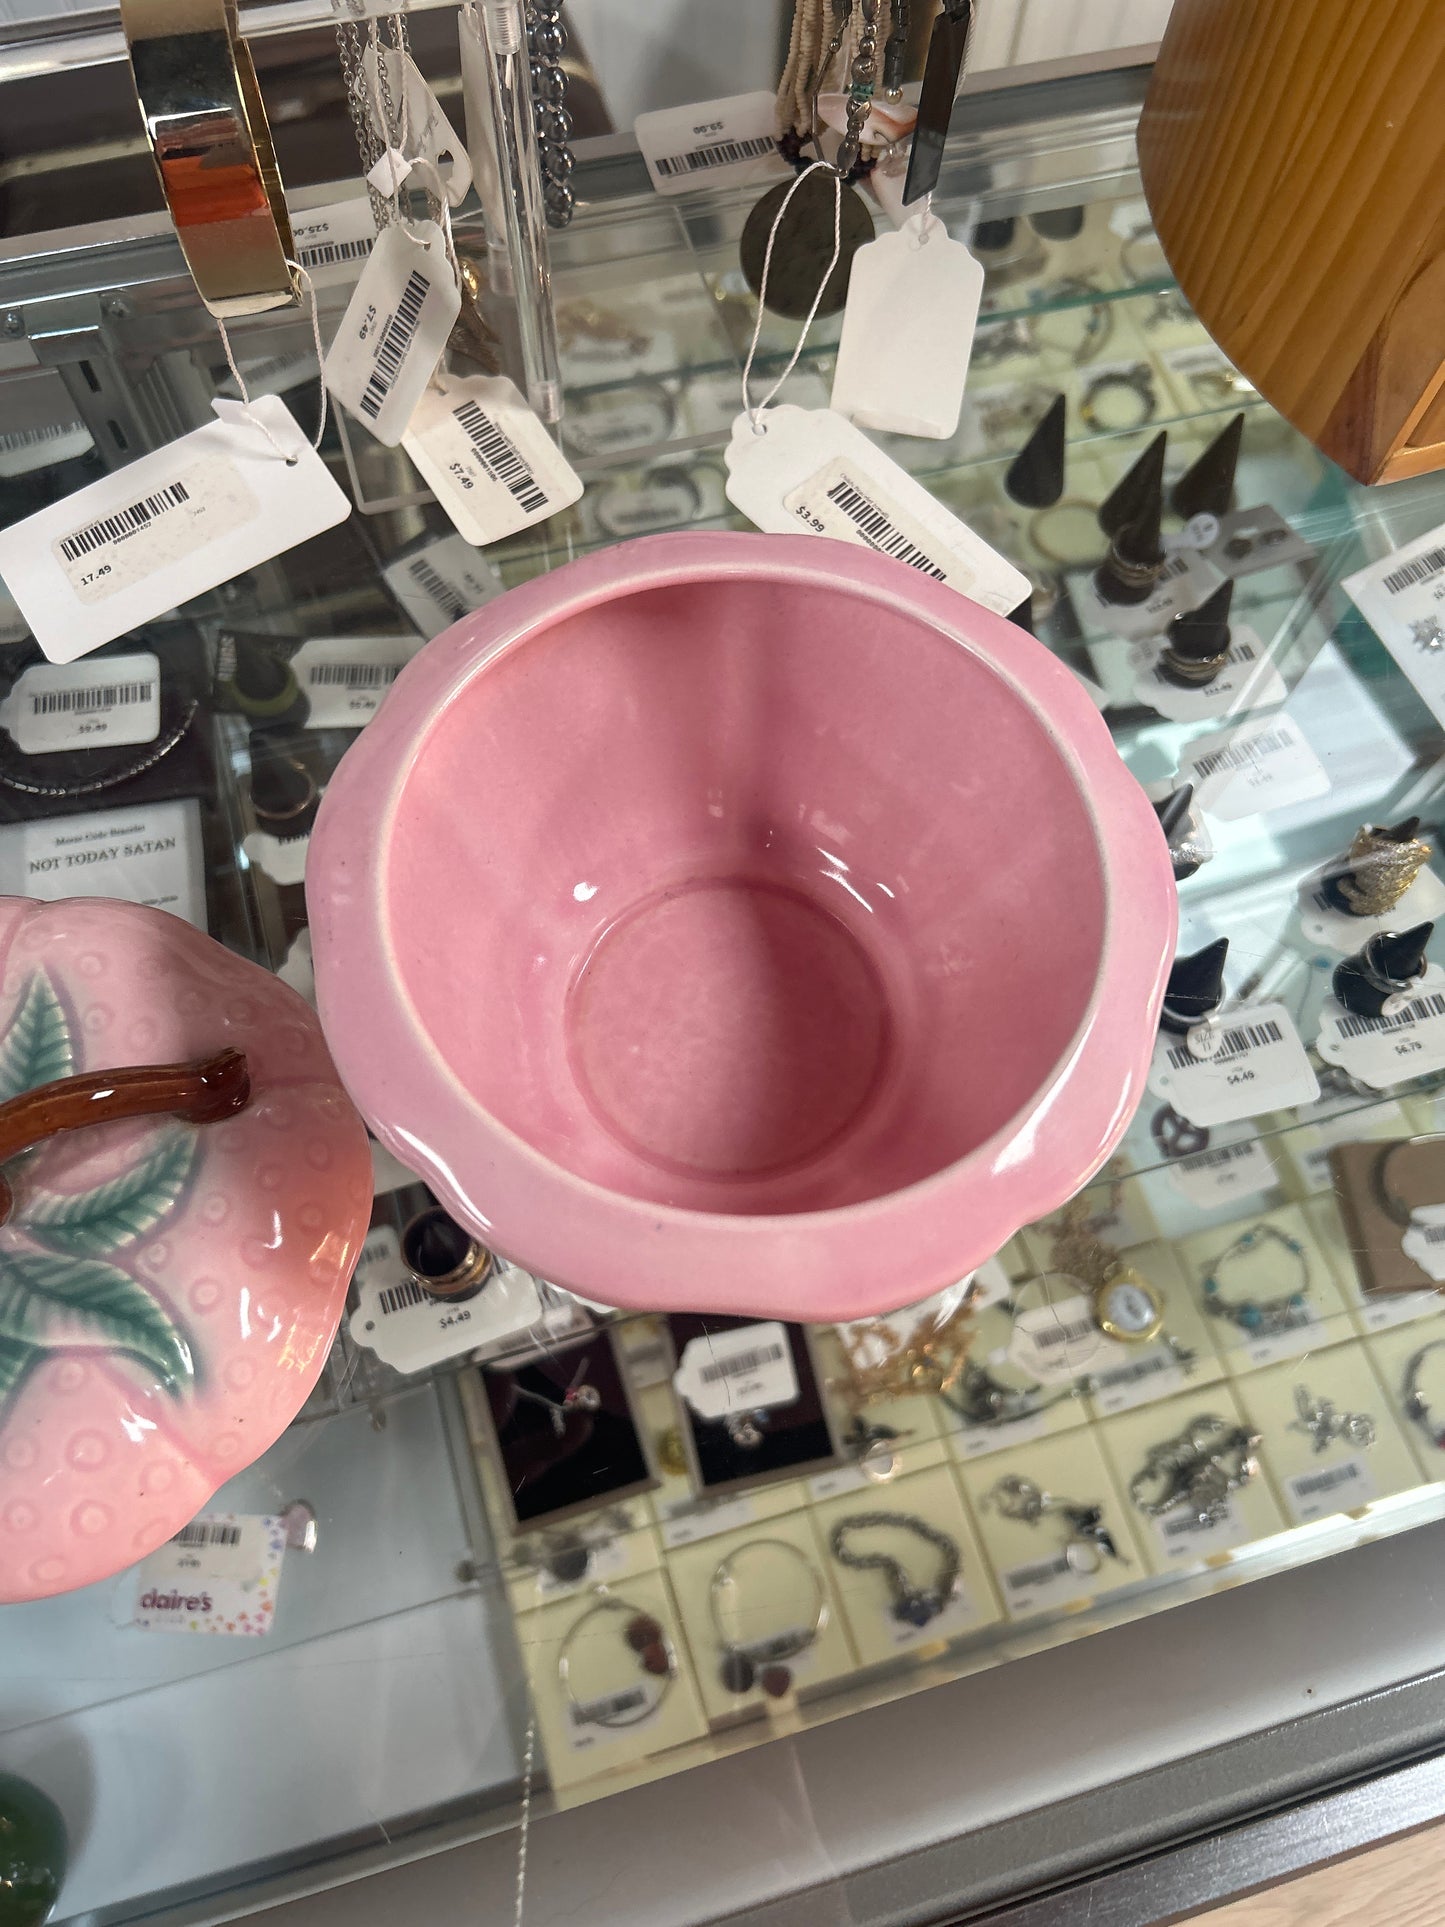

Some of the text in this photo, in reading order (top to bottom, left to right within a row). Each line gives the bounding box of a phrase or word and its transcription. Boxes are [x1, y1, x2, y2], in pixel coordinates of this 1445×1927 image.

[359, 304, 377, 340] $7.49
[449, 462, 475, 490] $7.49
[795, 505, 826, 533] $3.99
[80, 564, 113, 586] 17.49
[29, 837, 177, 874] NOT TODAY SATAN
[439, 1309, 472, 1329] $4.49
